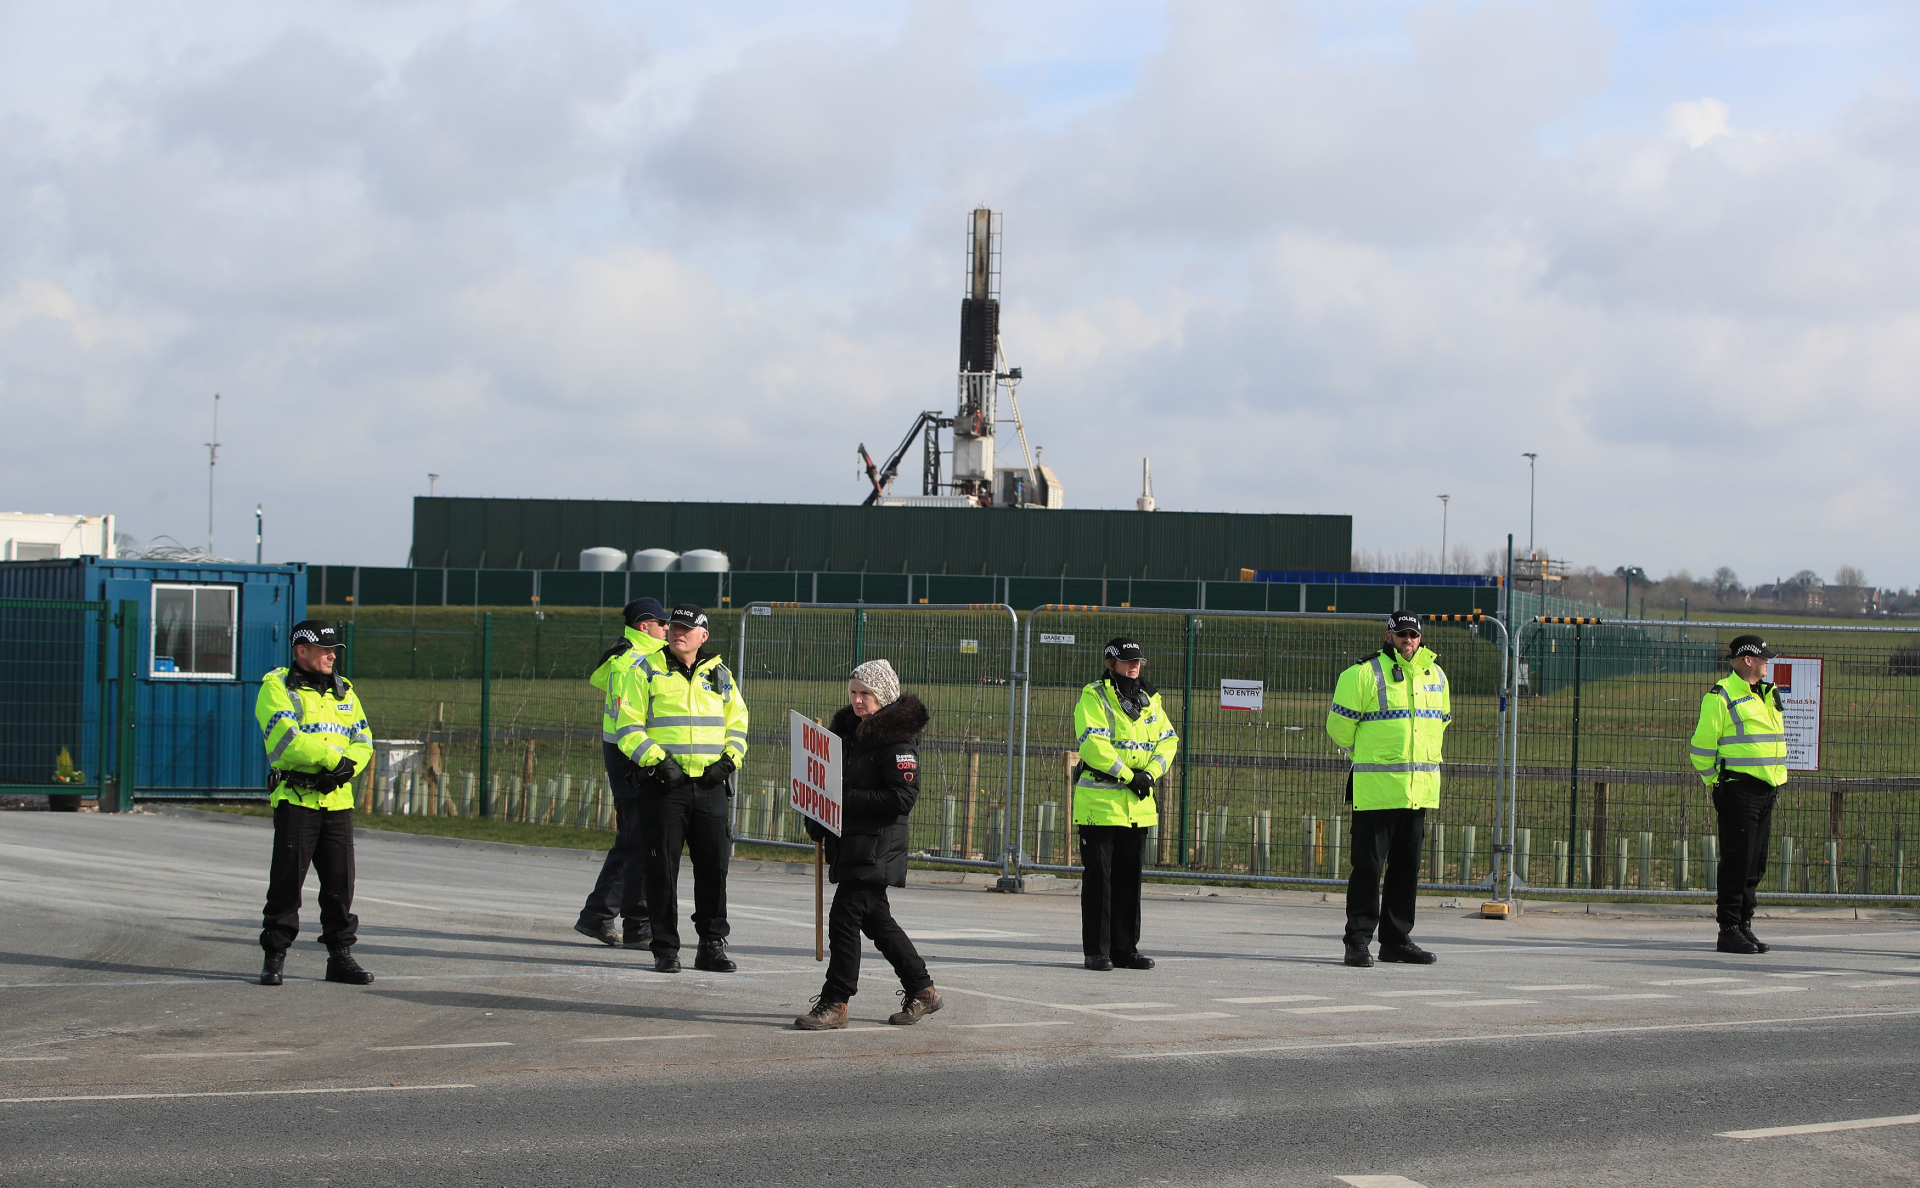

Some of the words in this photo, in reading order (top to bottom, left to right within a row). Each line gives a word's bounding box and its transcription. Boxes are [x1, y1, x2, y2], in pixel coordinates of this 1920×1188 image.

[674, 609, 694, 618] POLICE
[1398, 615, 1417, 623] POLICE
[802, 722, 831, 764] HONK
[807, 756, 826, 791] FOR
[792, 778, 841, 830] SUPPORT!
